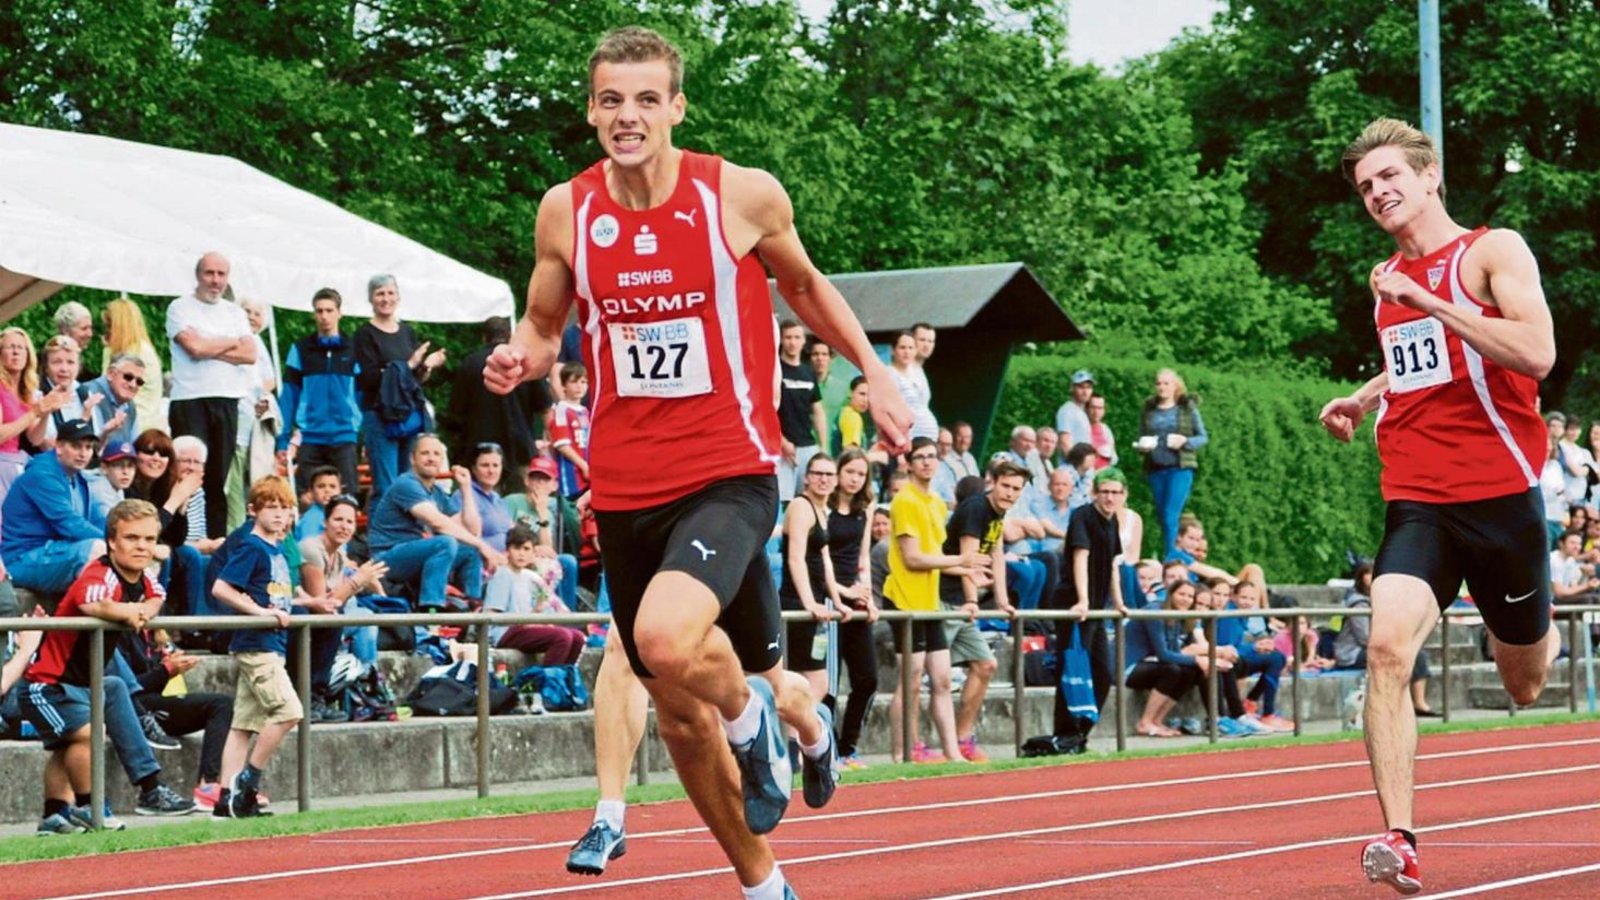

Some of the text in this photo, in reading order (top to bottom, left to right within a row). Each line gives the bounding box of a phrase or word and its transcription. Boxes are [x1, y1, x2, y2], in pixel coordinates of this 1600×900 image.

[603, 292, 705, 314] OLYMP
[628, 343, 688, 379] 127
[1393, 338, 1438, 376] 913
